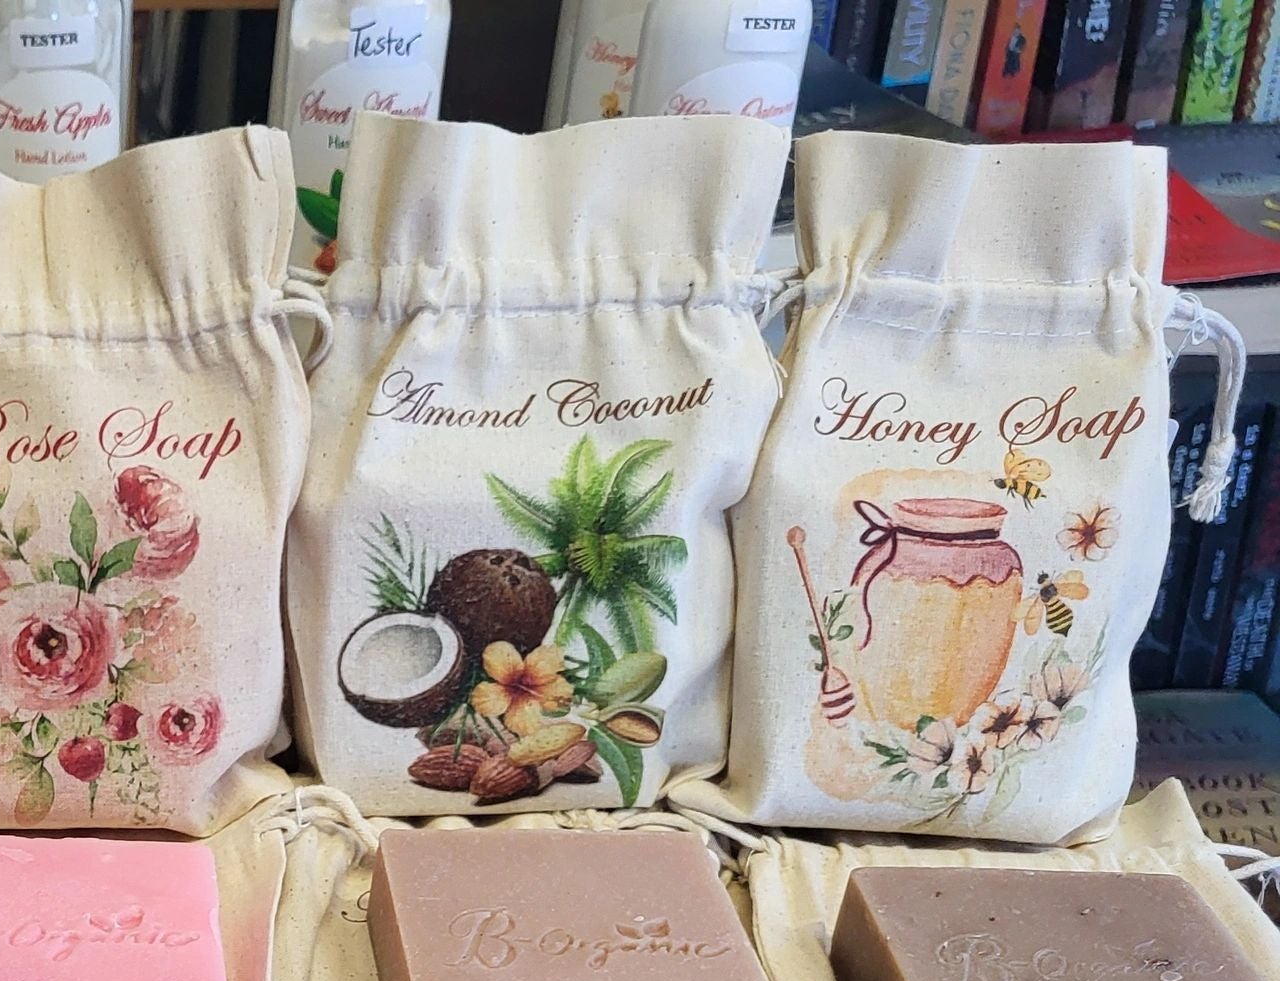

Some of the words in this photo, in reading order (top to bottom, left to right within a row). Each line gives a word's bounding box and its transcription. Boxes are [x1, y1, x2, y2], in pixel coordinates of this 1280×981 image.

[20, 32, 78, 48] TESTER
[350, 21, 422, 58] Tester
[742, 17, 796, 31] TESTER
[366, 370, 537, 429] Almond
[546, 376, 715, 428] Coconut
[813, 376, 982, 466] Honey
[998, 386, 1146, 461] Soap
[98, 399, 243, 481] Soap
